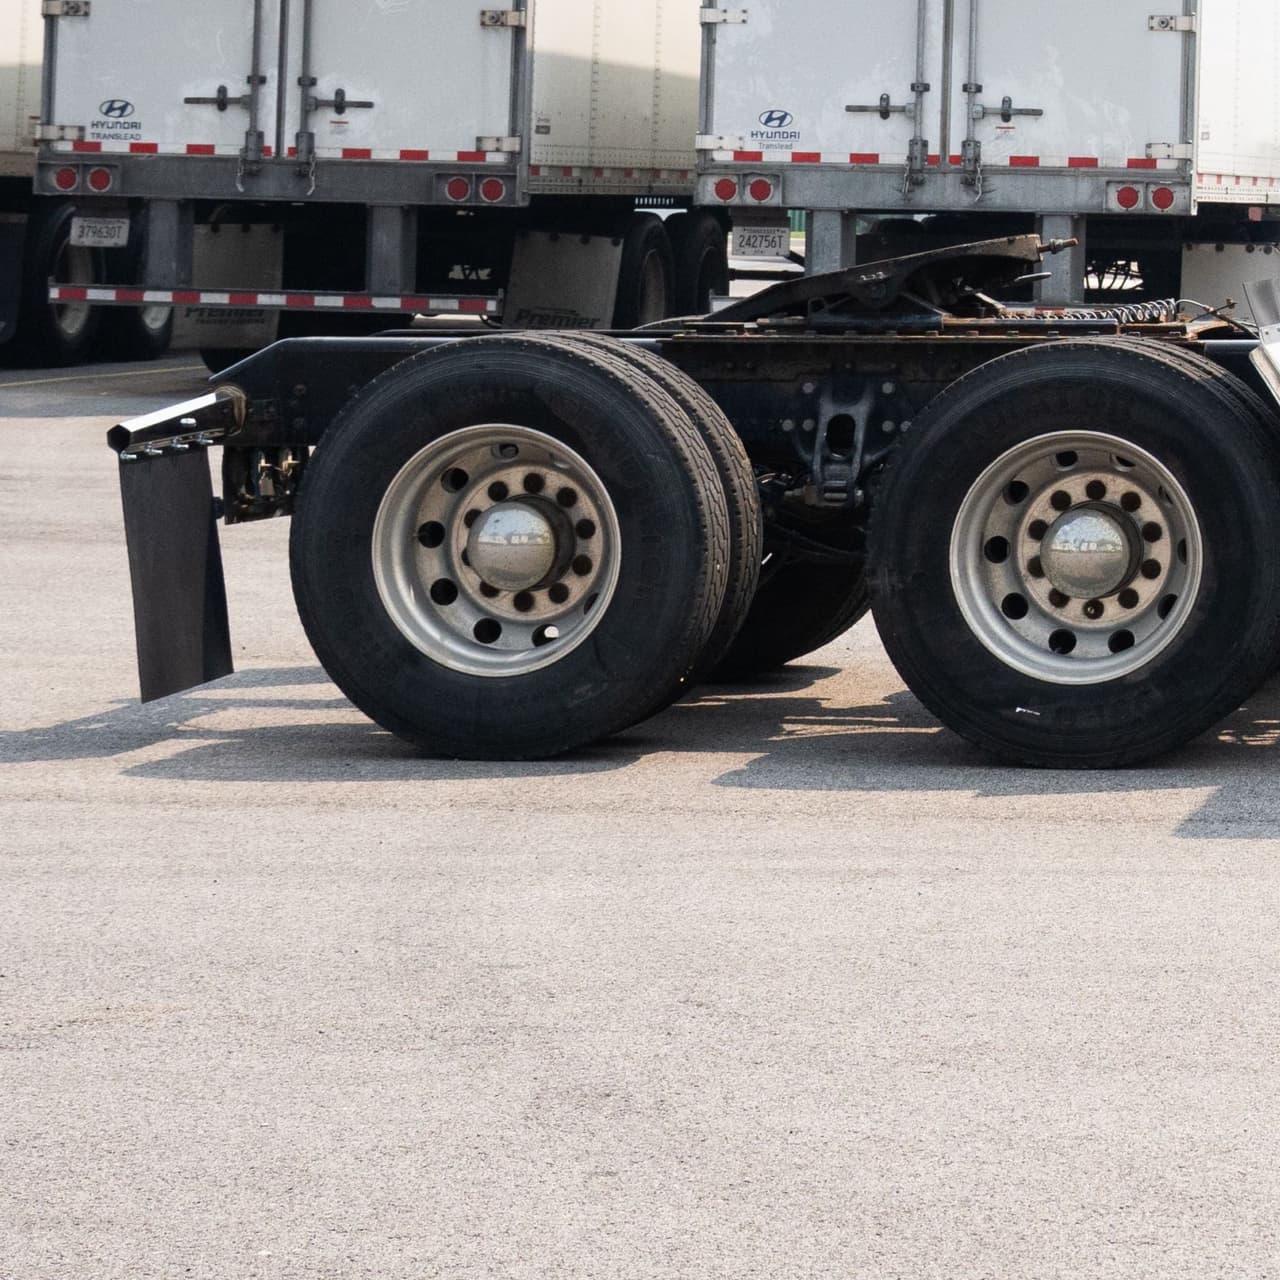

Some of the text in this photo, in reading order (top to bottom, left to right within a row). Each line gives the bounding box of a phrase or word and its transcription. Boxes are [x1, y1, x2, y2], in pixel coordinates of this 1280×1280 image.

[91, 120, 142, 130] HYUNDAI
[90, 132, 142, 140] TRANSLEAD
[751, 130, 801, 139] HYUNDAI
[758, 142, 793, 150] Translead
[739, 234, 784, 249] 242756T
